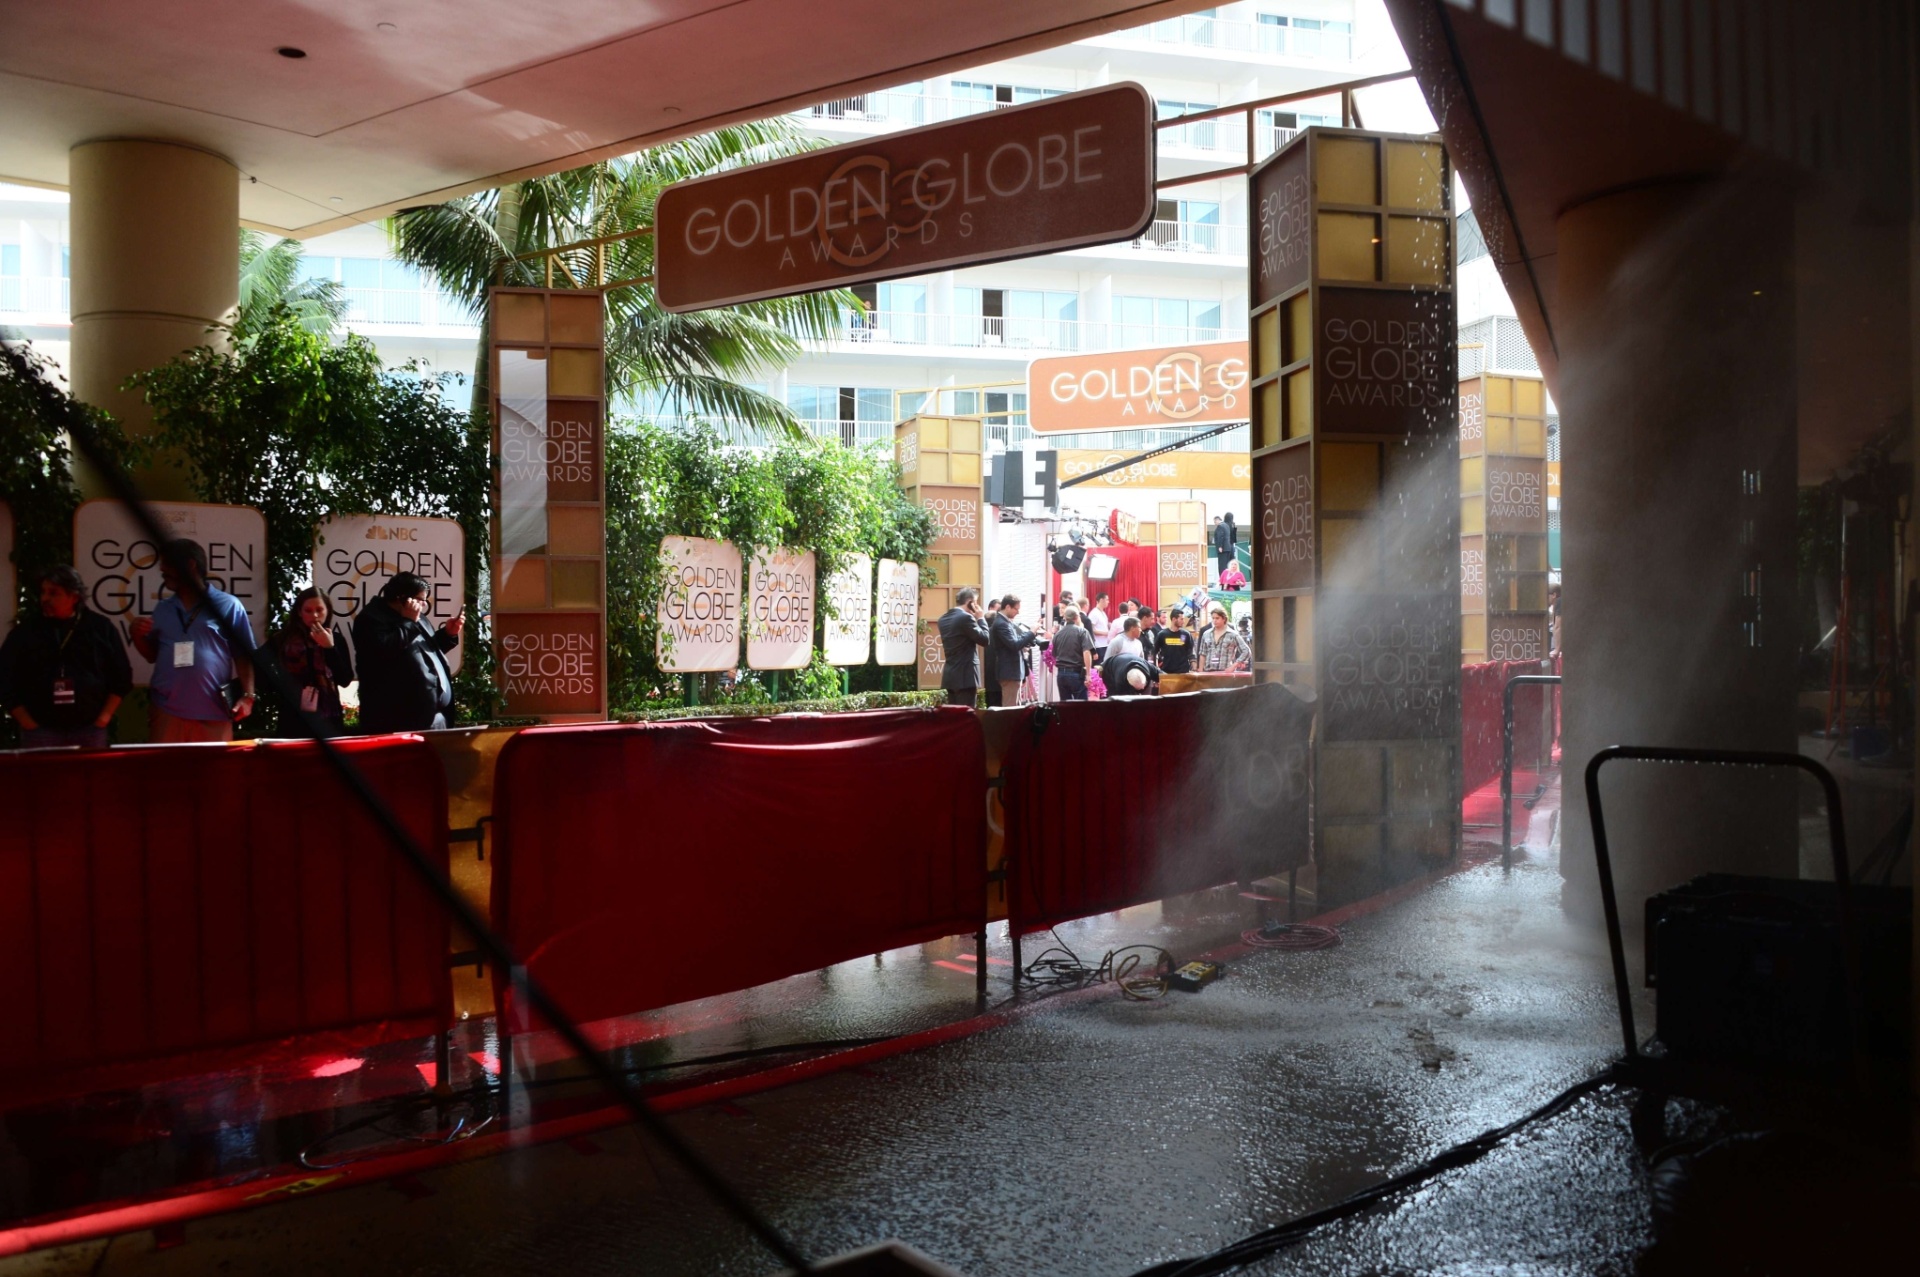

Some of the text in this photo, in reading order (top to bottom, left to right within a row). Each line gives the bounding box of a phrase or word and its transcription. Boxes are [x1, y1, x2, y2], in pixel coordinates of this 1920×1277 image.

[685, 125, 1104, 256] GOLDEN GLOBE
[1259, 175, 1309, 223] GOLDEN
[1259, 200, 1310, 256] GLOBE
[778, 212, 974, 272] AWARDS
[1324, 318, 1439, 346] GOLDEN
[1324, 346, 1439, 382] GLOBE
[1051, 359, 1200, 402] GOLDEN
[1122, 394, 1237, 416] AWARD
[1326, 382, 1440, 408] AWARDS
[1460, 393, 1482, 410] DEN
[501, 420, 592, 438] GOLDEN
[1460, 425, 1482, 441] RDS
[502, 440, 592, 464] GLOBE
[502, 465, 592, 482] AWARDS
[1130, 463, 1177, 476] GLOBE
[1489, 471, 1540, 486] GOLDEN
[1262, 475, 1312, 506] GOLDEN
[1489, 485, 1540, 504] GLOBE
[923, 498, 976, 511] GOLDEN
[1490, 505, 1540, 518] AWARDS
[1262, 501, 1312, 540] GLOBE
[388, 528, 418, 541] NBC
[936, 528, 976, 539] WARDS
[92, 539, 253, 571] GOEN
[1160, 552, 1198, 560] GOLDEN
[1263, 536, 1313, 564] AWARDS
[1461, 551, 1483, 564] DEN
[326, 549, 453, 578] GOLDEN
[1160, 561, 1198, 571] GLOBE
[1160, 570, 1198, 578] AWARDS
[667, 565, 737, 589] GOLDEN
[755, 571, 811, 593] GOLDEN
[829, 574, 868, 595] GOLDEN
[92, 575, 253, 615] GLE
[327, 581, 452, 617] GLE
[881, 582, 915, 601] GOLDEN
[1462, 582, 1483, 597] RDS
[665, 591, 735, 621] GLOBE
[754, 594, 809, 623] GLOBE
[880, 602, 915, 626] GLOBE
[502, 633, 594, 652] GOLDEN
[665, 624, 734, 643] AWARDS
[755, 625, 809, 643] AWARDS
[880, 627, 914, 643] AWARDS
[1328, 624, 1442, 649] GOLDEN
[1490, 628, 1541, 642] GOLDEN
[1490, 642, 1541, 660] GLOBE
[502, 653, 594, 677] GLOBE
[1328, 652, 1442, 686] GLOBE
[504, 678, 594, 694] AWARDS
[1328, 687, 1442, 712] AWARDS
